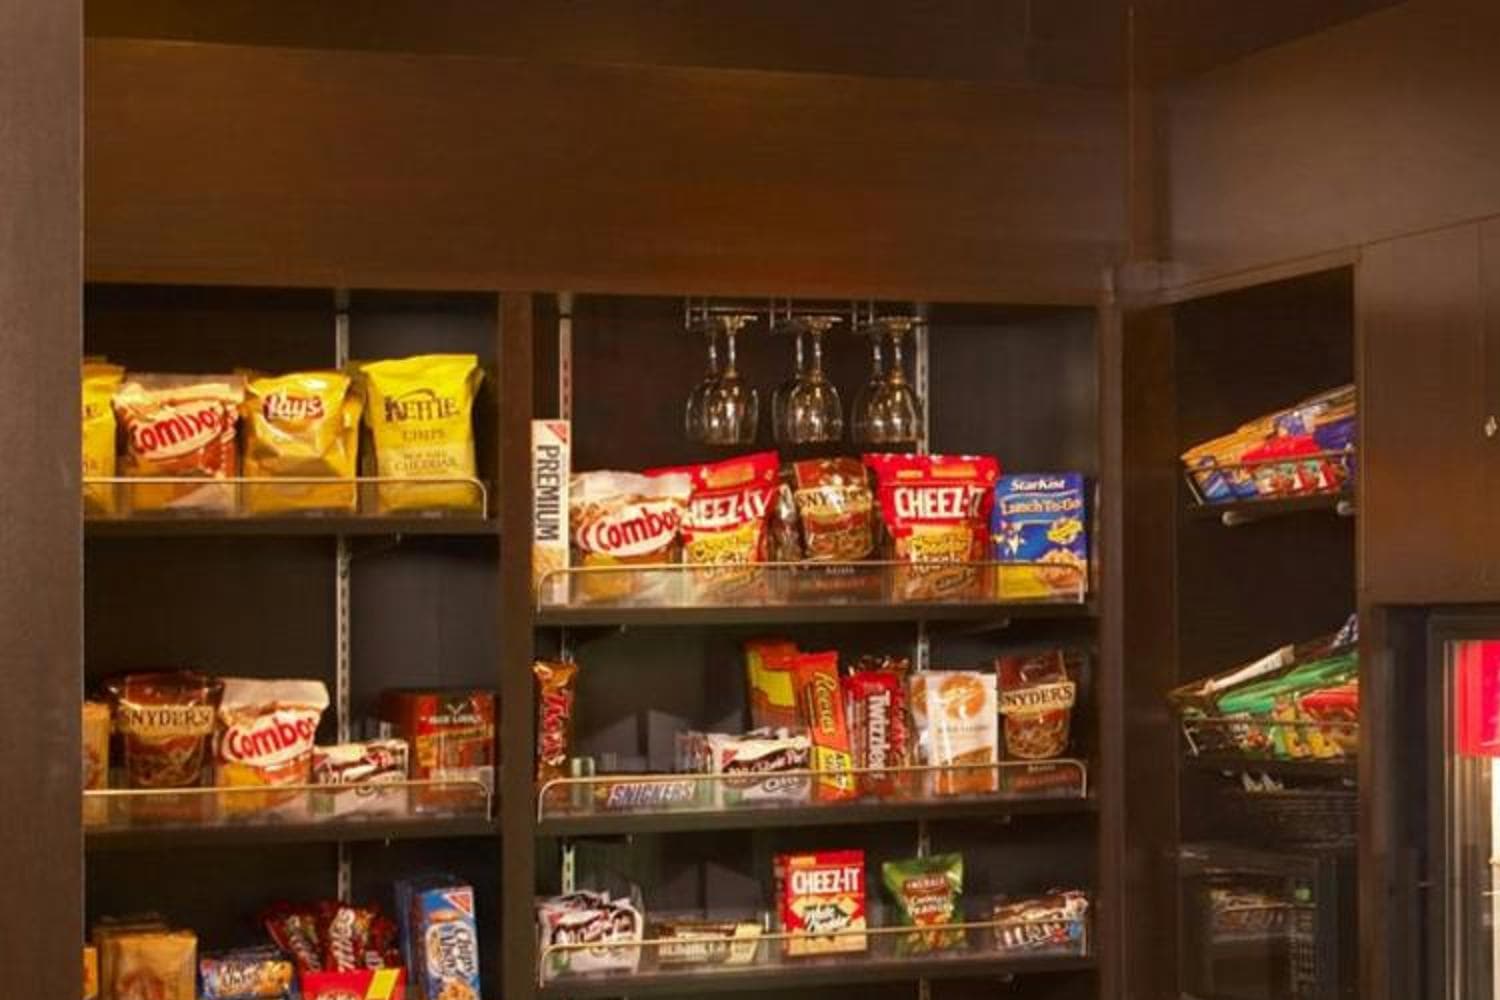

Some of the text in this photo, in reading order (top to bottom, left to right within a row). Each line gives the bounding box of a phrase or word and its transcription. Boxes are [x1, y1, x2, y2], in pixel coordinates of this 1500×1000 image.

[536, 444, 571, 542] PREMIUM
[683, 486, 770, 528] HEEZ-IT
[893, 486, 986, 519] CHEEZ-IT
[791, 868, 861, 896] CHEEZ-IT
